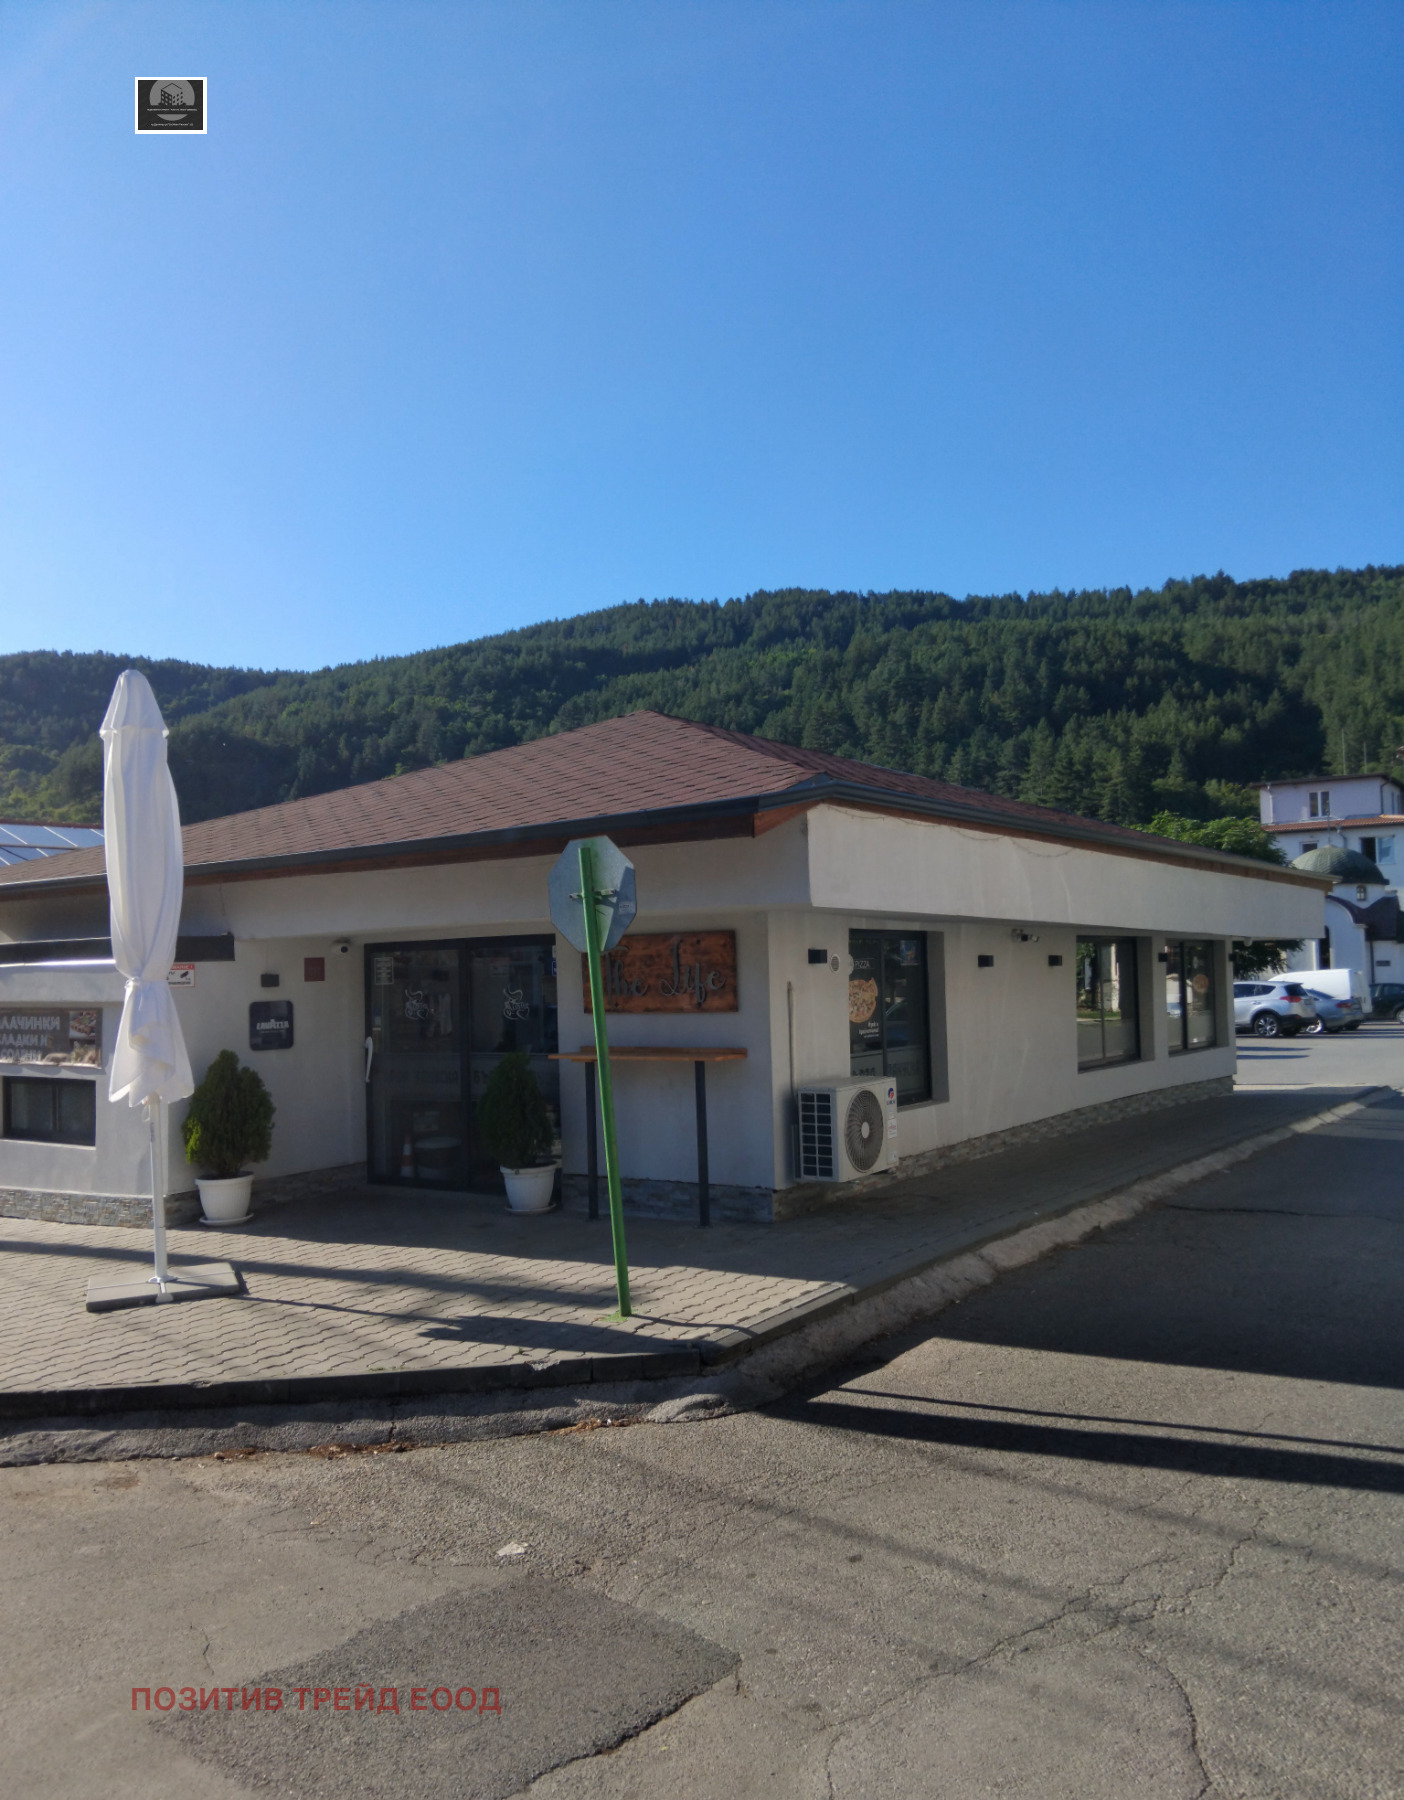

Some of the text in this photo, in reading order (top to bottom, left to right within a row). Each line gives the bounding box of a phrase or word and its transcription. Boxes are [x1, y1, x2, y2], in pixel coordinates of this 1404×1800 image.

[659, 936, 726, 1005] Life
[854, 960, 869, 968] PIZZA
[0, 1016, 60, 1030] ЛАЧИНКИ
